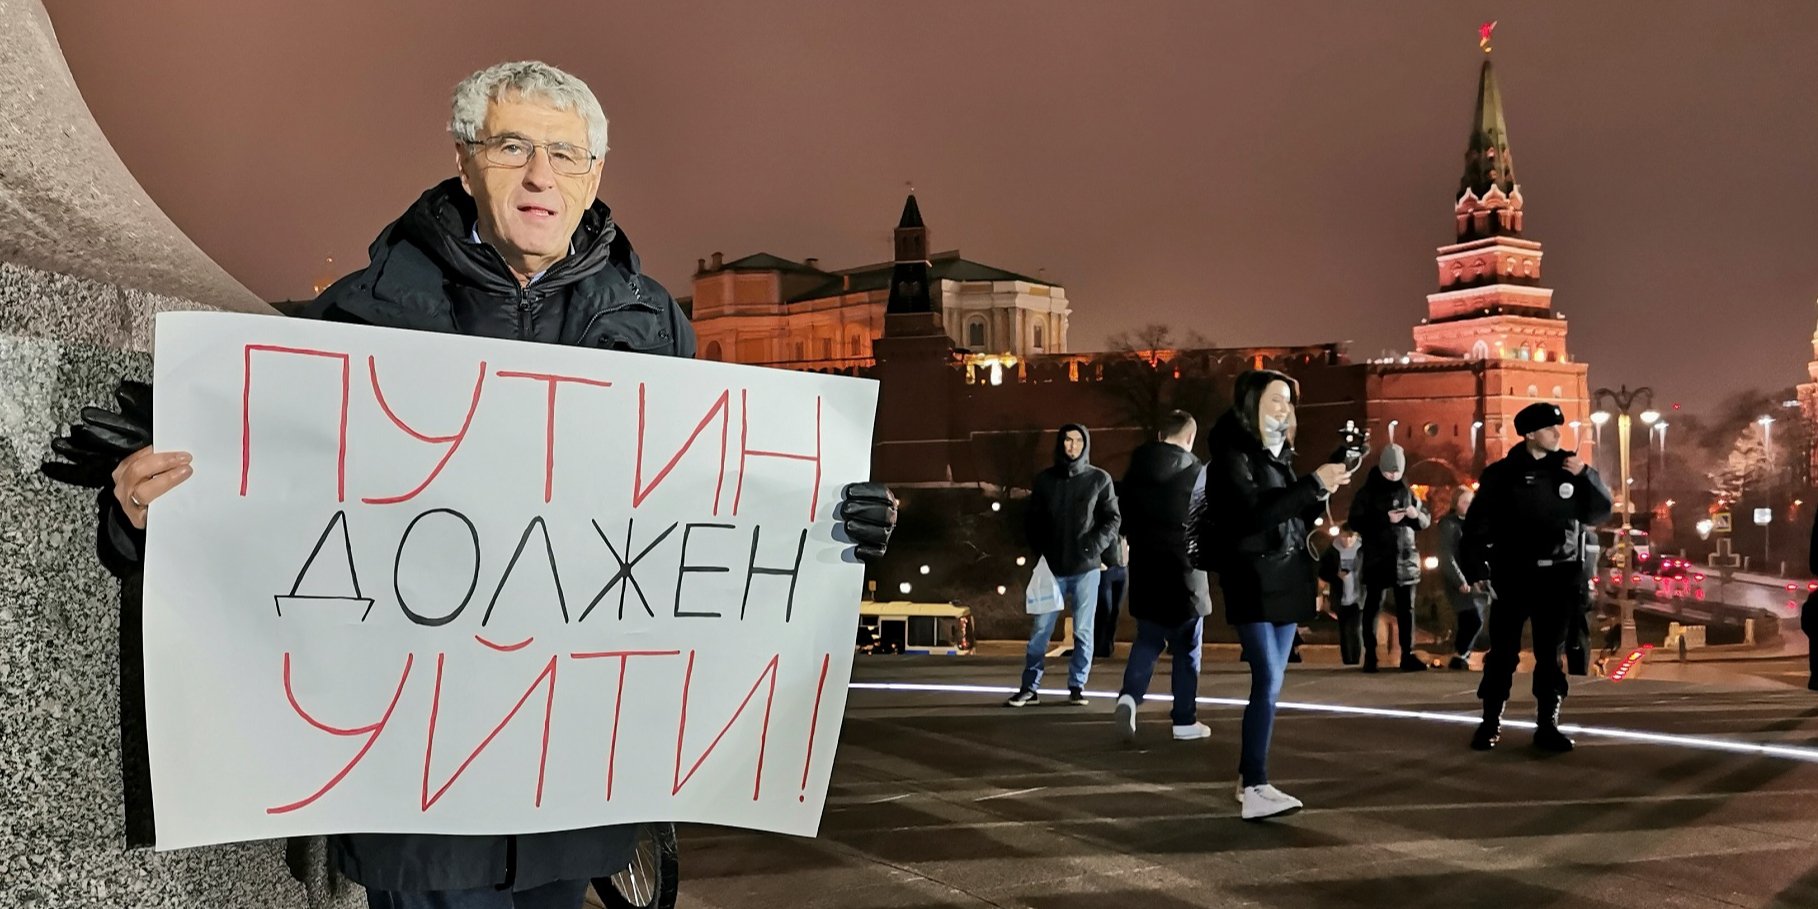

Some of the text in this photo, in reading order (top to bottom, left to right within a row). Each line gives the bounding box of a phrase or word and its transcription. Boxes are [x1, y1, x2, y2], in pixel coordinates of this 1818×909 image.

[239, 343, 822, 522] ПУТИН
[273, 507, 808, 627] ДОЛЖЕН
[267, 636, 830, 814] УЙТИ!
